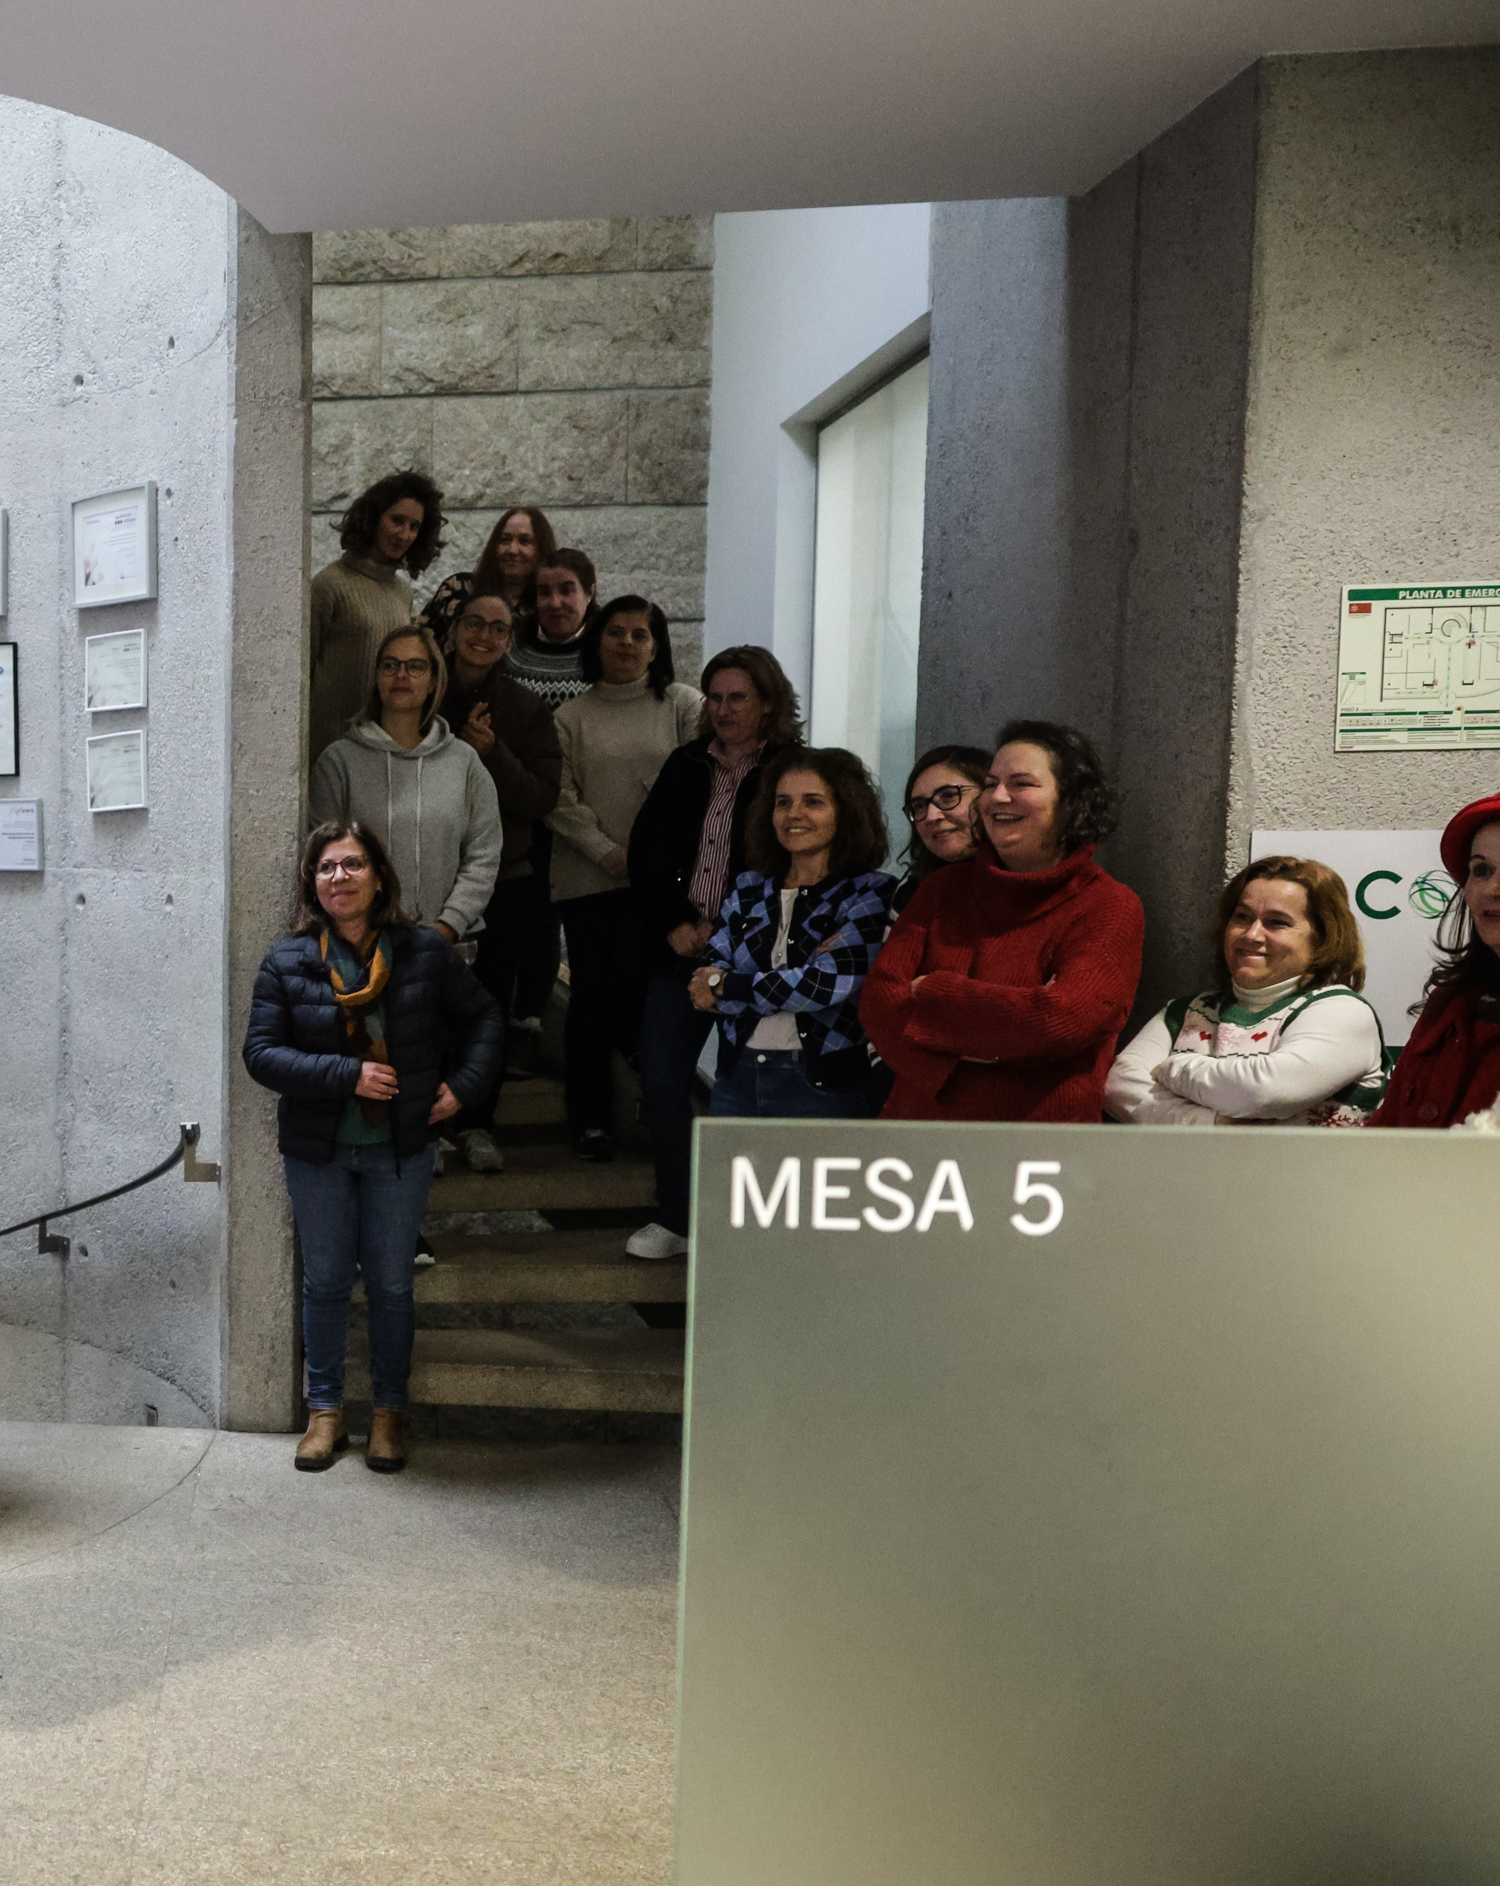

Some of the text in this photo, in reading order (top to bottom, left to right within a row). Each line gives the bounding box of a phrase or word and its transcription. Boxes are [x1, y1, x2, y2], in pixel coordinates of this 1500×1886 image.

[1398, 589, 1443, 600] PLANTA
[1446, 589, 1462, 598] DE
[730, 1156, 1064, 1236] MESA 5
